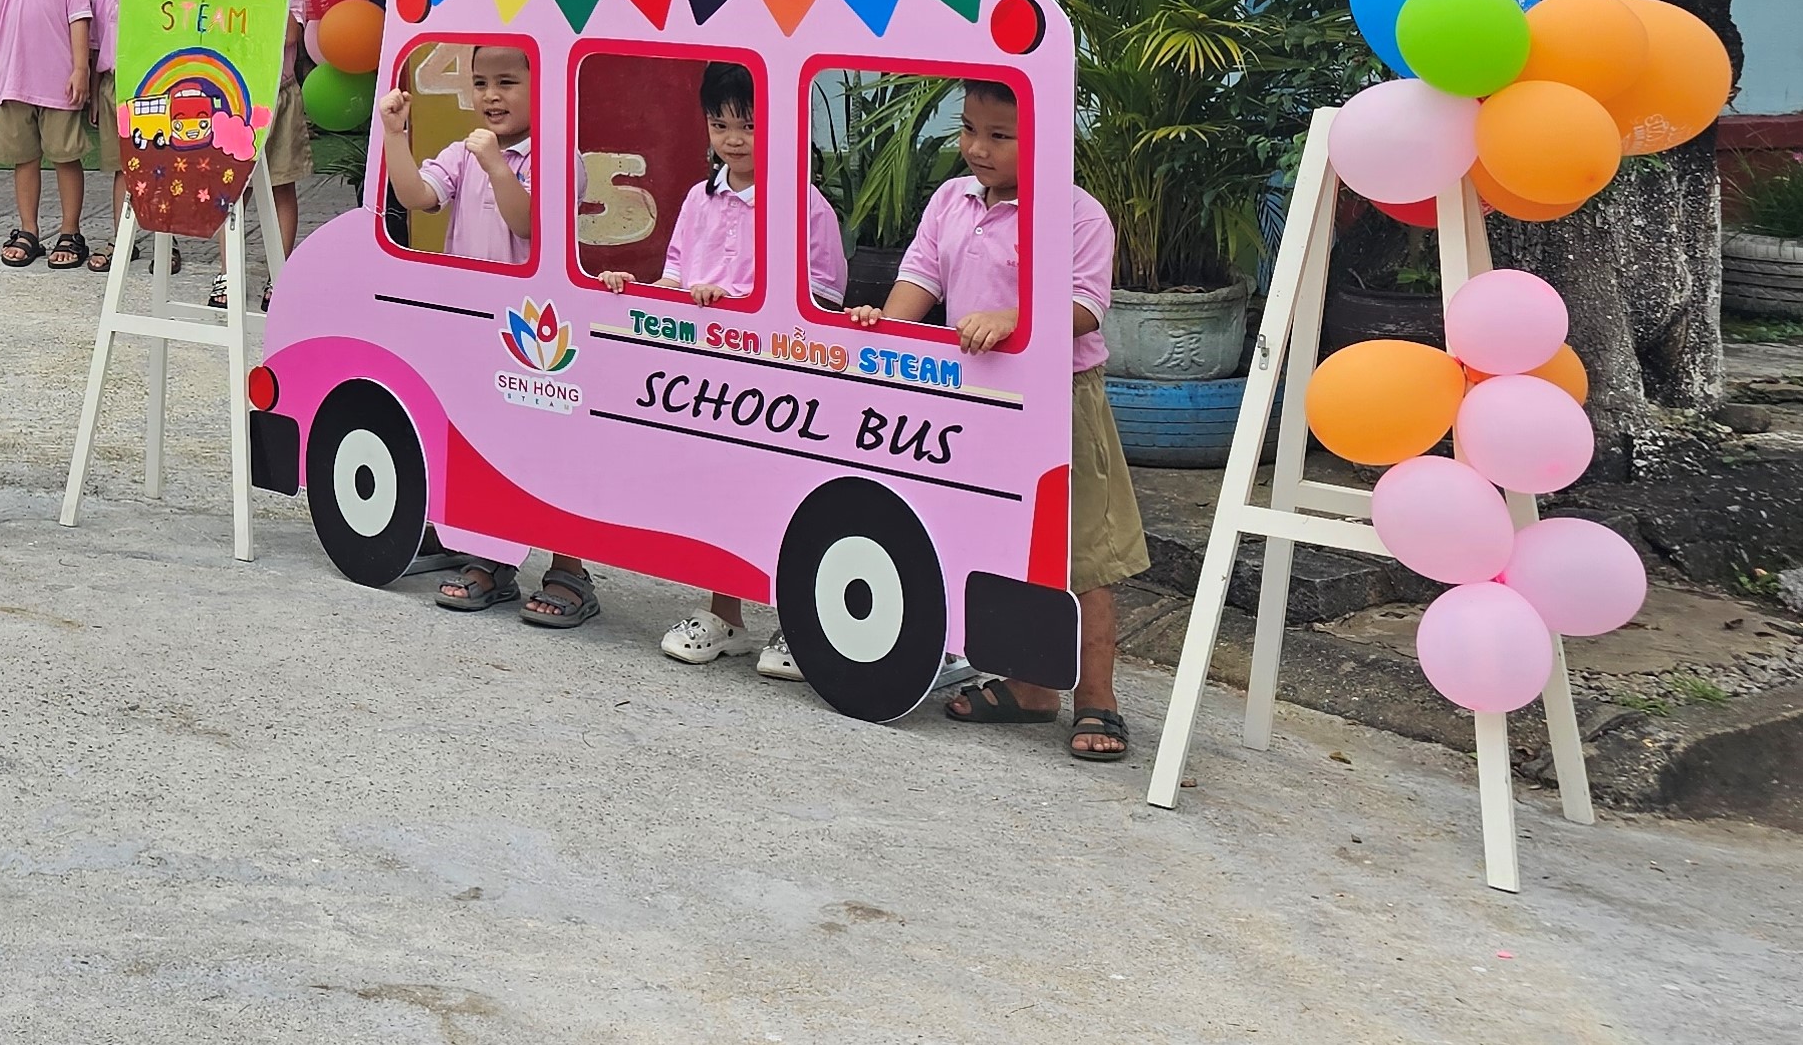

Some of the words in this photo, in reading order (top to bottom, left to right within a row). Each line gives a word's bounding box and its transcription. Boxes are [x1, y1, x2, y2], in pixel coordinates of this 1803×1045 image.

[161, 0, 248, 35] STEAM
[578, 151, 658, 246] 5
[498, 375, 528, 393] SEN
[629, 309, 697, 344] Team
[770, 326, 849, 372] Hồng
[858, 349, 963, 389] STEAM
[635, 371, 829, 443] SCHOOL
[855, 407, 964, 465] BUS
